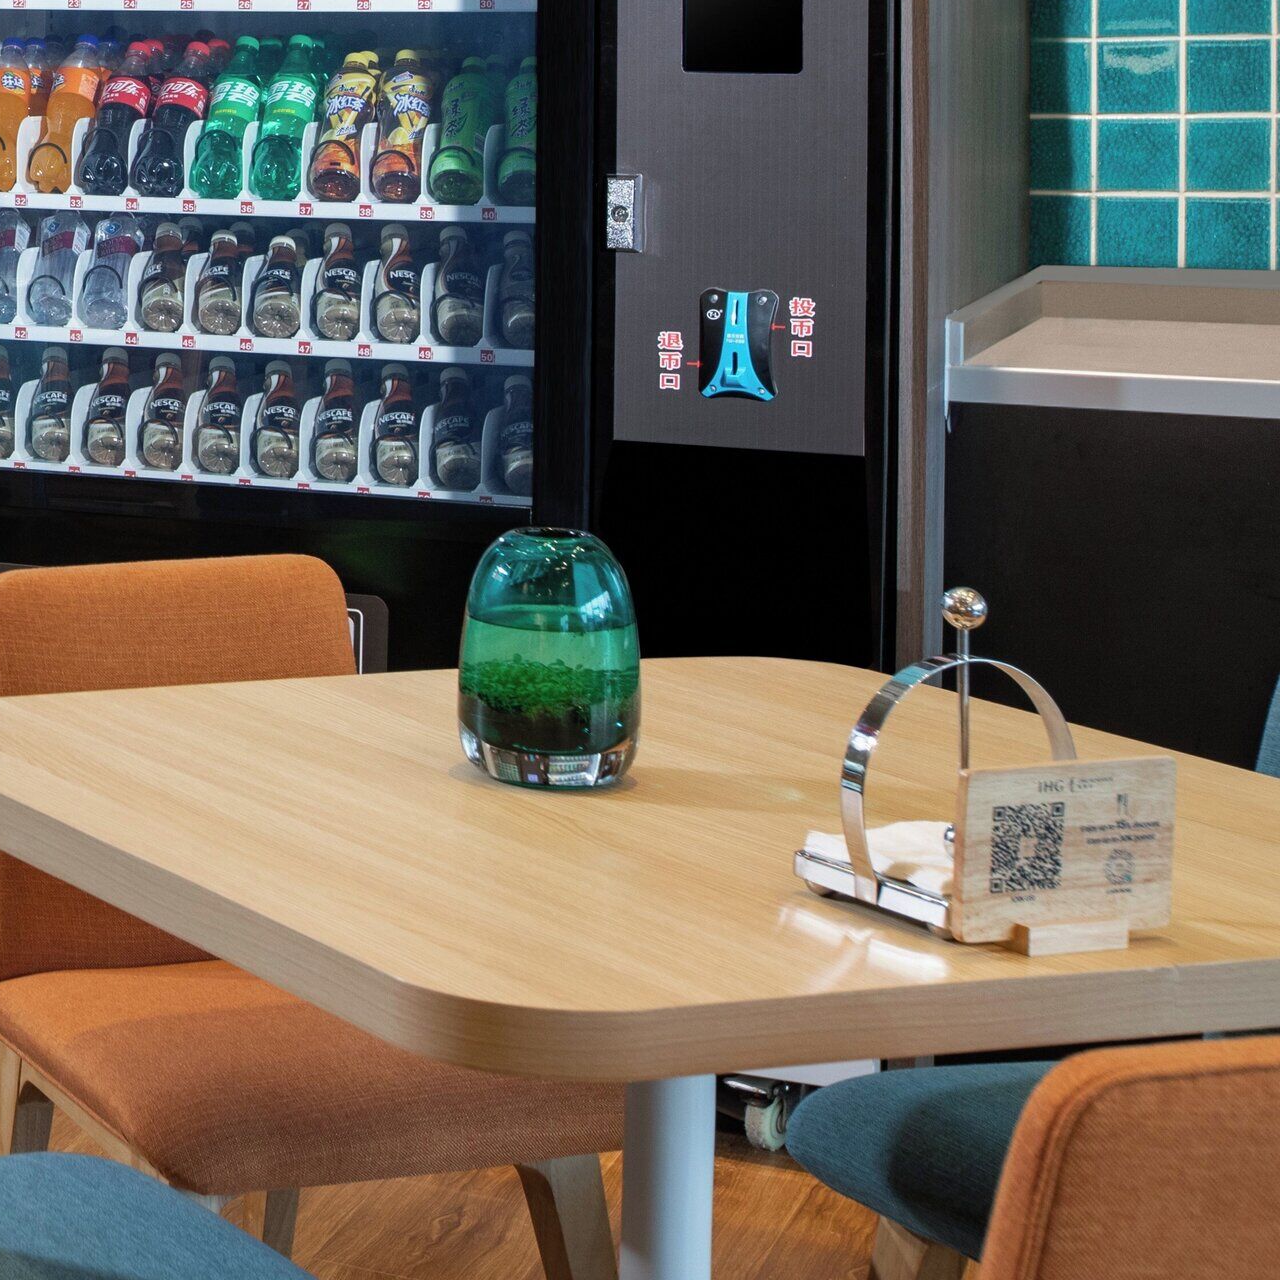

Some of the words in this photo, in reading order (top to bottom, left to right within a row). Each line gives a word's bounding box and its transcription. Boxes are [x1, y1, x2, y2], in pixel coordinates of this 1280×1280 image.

[14, 0, 24, 7] 22
[298, 1, 309, 9] 27
[358, 1, 369, 9] 28
[480, 0, 492, 8] 30
[1, 74, 24, 90] 芬达
[212, 81, 260, 107] 雪碧
[267, 80, 317, 107] 雪碧
[327, 94, 366, 118] 冰红茶
[70, 199, 81, 207] 33
[126, 201, 137, 209] 34
[183, 203, 194, 211] 35
[241, 204, 252, 212] 36
[300, 206, 311, 214] 37
[360, 208, 371, 216] 38
[421, 210, 432, 218] 39
[483, 211, 495, 219] 40
[390, 271, 416, 280] NESC
[789, 297, 816, 358] 投币口
[70, 332, 81, 340] 43
[126, 335, 137, 344] 44
[182, 339, 193, 347] 45
[240, 342, 251, 350] 46
[299, 345, 310, 353] 47
[359, 348, 370, 356] 48
[419, 350, 431, 358] 49
[481, 353, 493, 361] 50
[658, 331, 683, 390] 退币口
[1039, 780, 1065, 793] IHG
